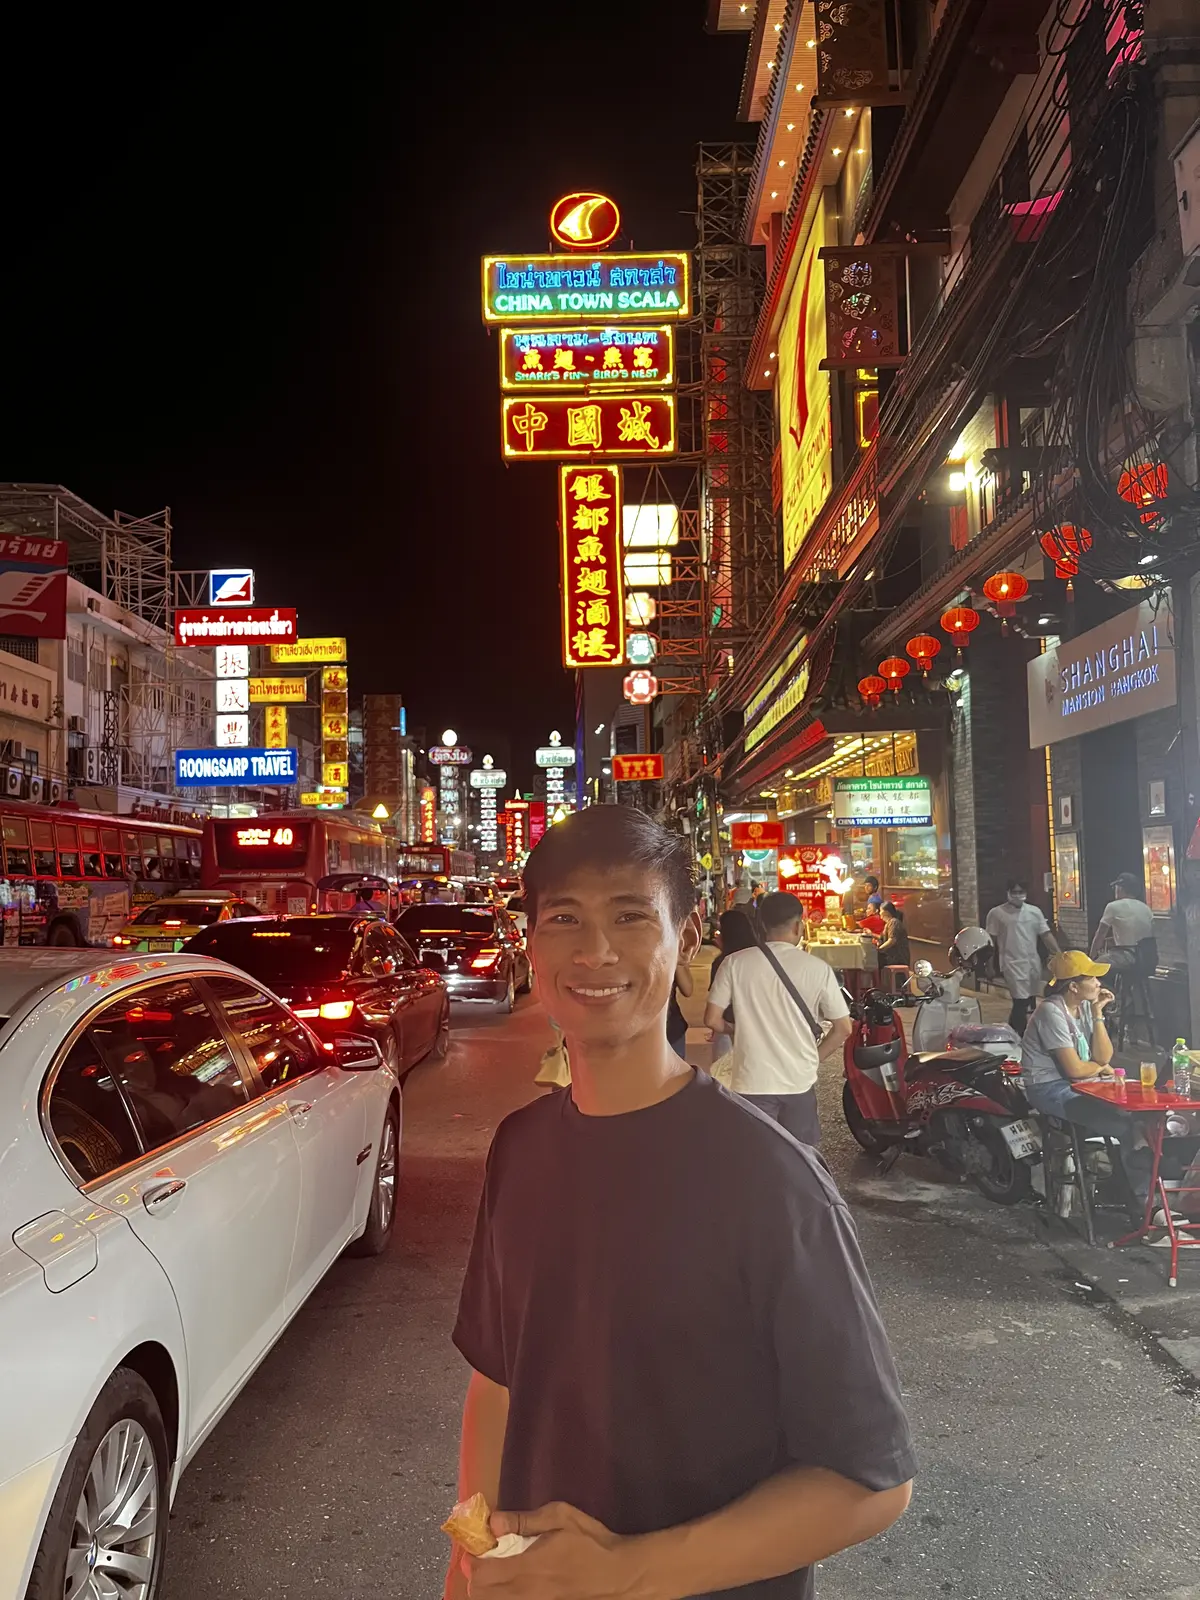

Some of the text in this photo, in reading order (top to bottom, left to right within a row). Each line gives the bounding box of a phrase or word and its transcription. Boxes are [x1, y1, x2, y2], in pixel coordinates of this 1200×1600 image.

[496, 261, 676, 289] ไชน่าทาวน์ สกาล่า
[495, 291, 680, 311] CHINA TOWN SCALA
[515, 371, 560, 382] SHARK'S
[593, 369, 629, 380] BIRD'S
[631, 368, 658, 379] NEST
[512, 401, 660, 452] 中國城
[786, 471, 828, 563] SCALA
[1060, 625, 1158, 694] SHANGHAI
[1062, 663, 1160, 717] MANSION BANGKOK
[179, 756, 294, 778] ROONGSARP TRAVEL
[873, 817, 892, 825] SCALA
[892, 816, 928, 824] RESTAURANT
[273, 828, 293, 845] 40
